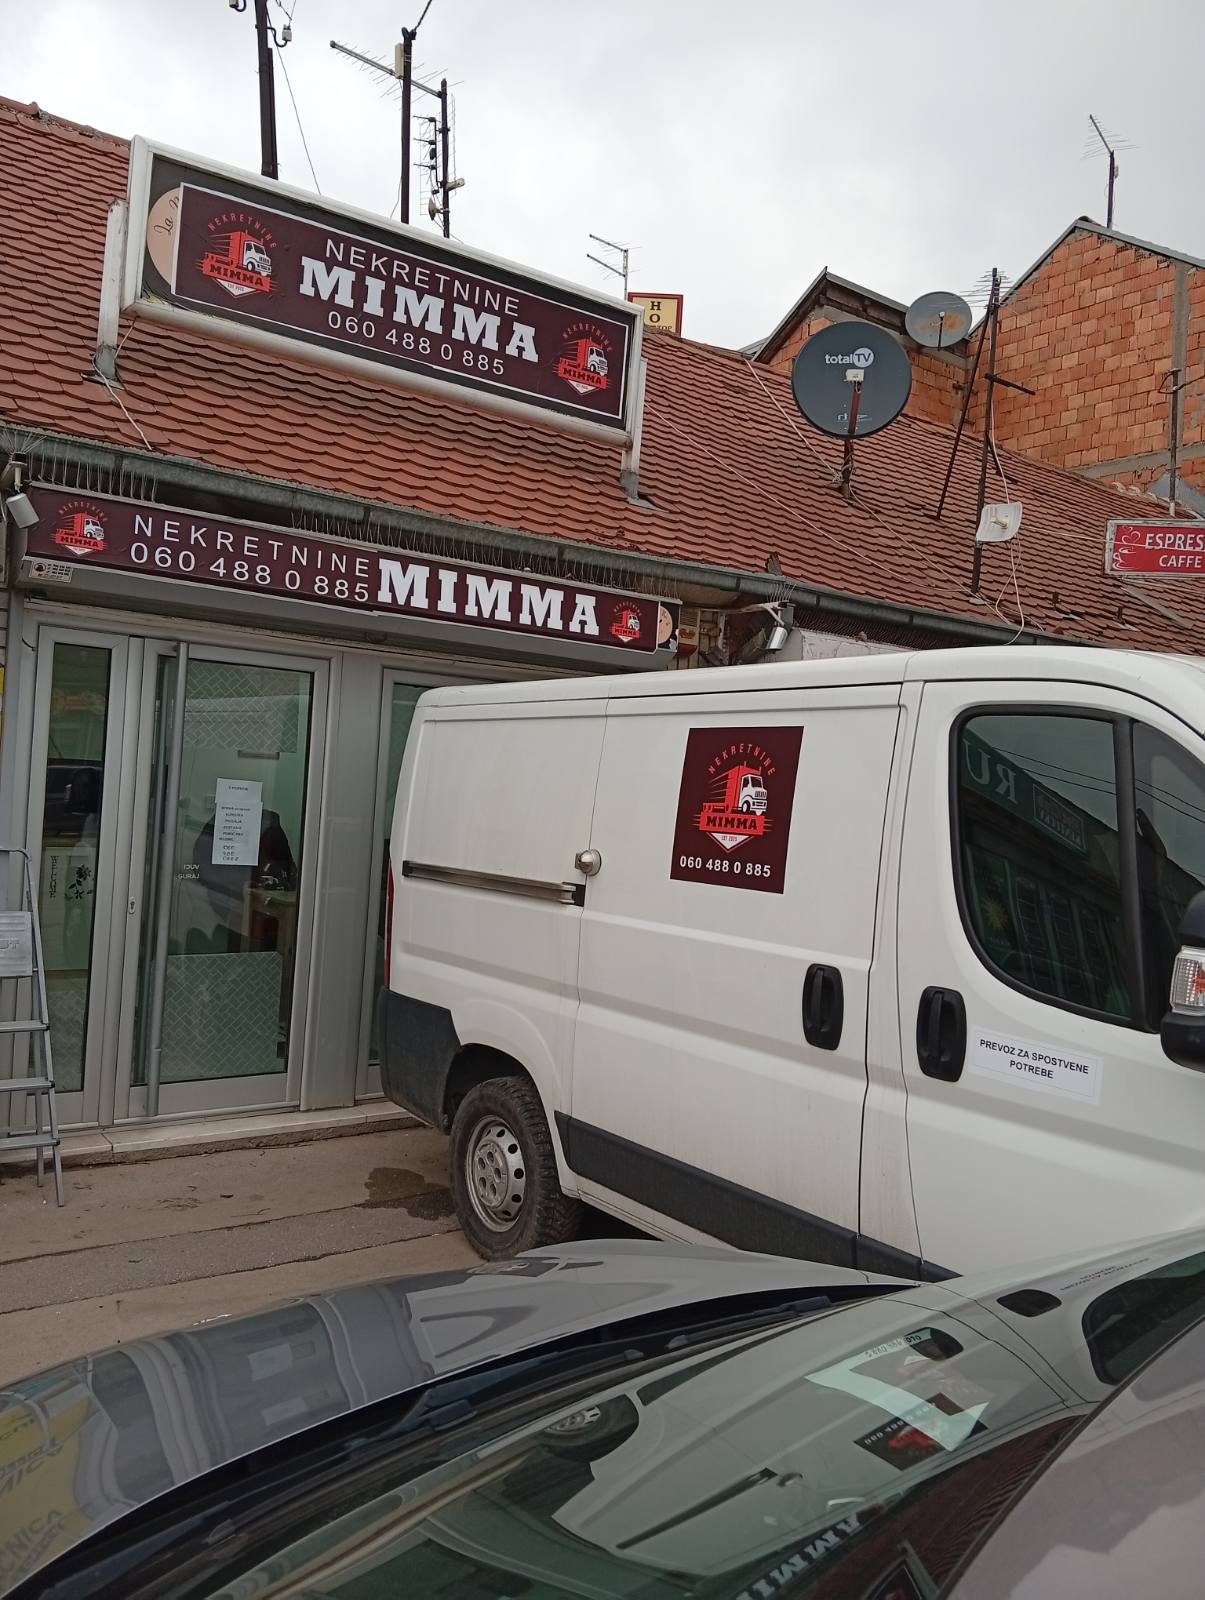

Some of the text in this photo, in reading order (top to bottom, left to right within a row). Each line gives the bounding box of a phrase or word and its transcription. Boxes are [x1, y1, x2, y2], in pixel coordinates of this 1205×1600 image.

[209, 263, 264, 287] MIMMA
[325, 238, 520, 317] NEKRETNINE
[299, 255, 539, 363] MIMMA
[328, 311, 504, 375] 060 488 0 885
[562, 367, 602, 385] MIMMA
[60, 535, 99, 548] MIMMA
[134, 514, 370, 578] NEKRETNINE
[130, 542, 369, 602] 060 488 0 885
[1158, 554, 1203, 569] CAFFE
[377, 557, 600, 636] MIMMA
[708, 743, 777, 776] NEKRETNINE
[705, 815, 758, 831] MIMMA
[679, 855, 771, 878] 060 488 0 885
[979, 1039, 1089, 1075] PREVOZ ZA SPOSTVENE
[1009, 1060, 1054, 1079] POTREBE
